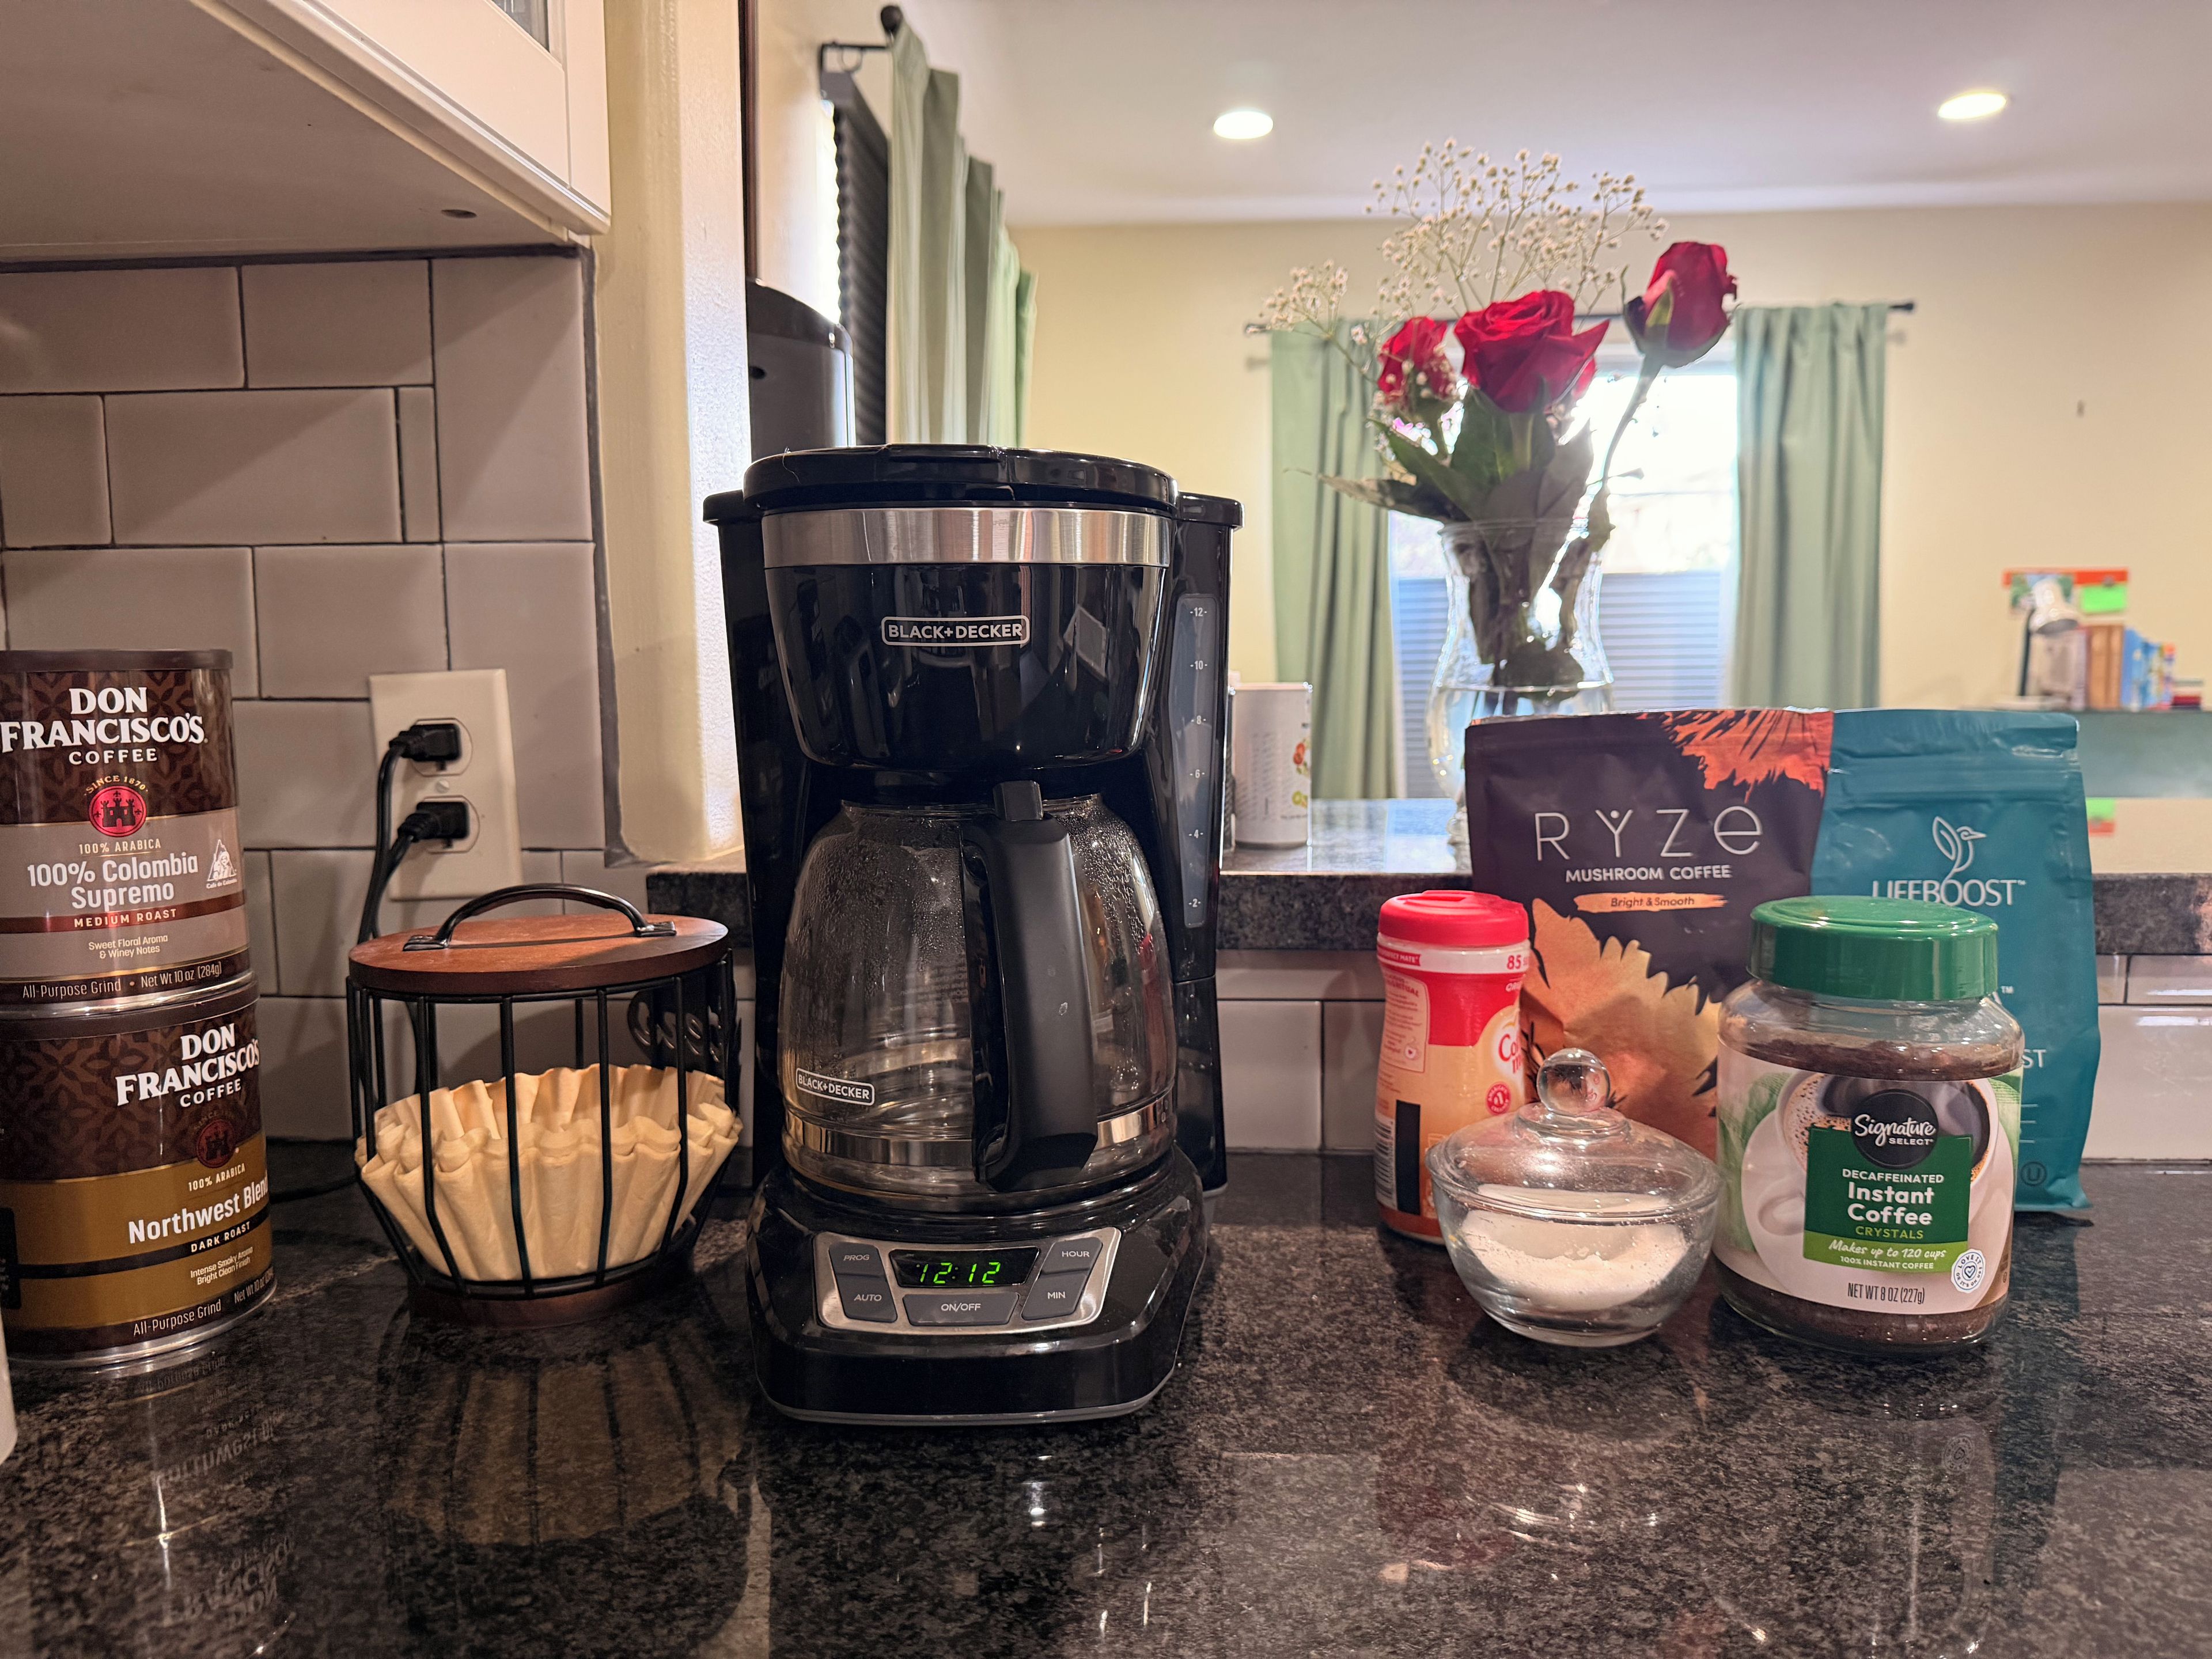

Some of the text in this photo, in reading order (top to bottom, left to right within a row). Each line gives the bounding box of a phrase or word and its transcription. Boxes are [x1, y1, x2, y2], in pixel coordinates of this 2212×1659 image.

[888, 624, 1022, 639] BLACK+DECKER
[69, 687, 147, 714] DON
[0, 713, 204, 752] FRANCISCO'S
[69, 748, 157, 765] COFFEE
[86, 775, 146, 793] SINCE 1870
[79, 839, 161, 854] 100% ARABICA
[28, 852, 198, 887] 100% Colombia
[1566, 865, 1731, 883] MUSHROOM COFFEE
[71, 882, 174, 911] Supremo
[1611, 896, 1694, 908] Bright & Smooth
[74, 908, 177, 927] MEDIUM ROAST
[89, 934, 168, 950] Sweet Floral Aroma
[99, 945, 160, 959] & Winey Notes
[1507, 955, 1521, 969] 85
[141, 963, 222, 988] Net Wt 10 oz (284g)
[23, 978, 121, 999] All-Purpose Grind
[180, 1023, 235, 1061] DON
[115, 1038, 260, 1107] FRANCISCO'S
[180, 1078, 241, 1108] COFFEE
[798, 1074, 870, 1100] BLACK+DECKER
[1854, 1113, 1937, 1147] Signature
[188, 1163, 245, 1192] 100% ARABICA
[1842, 1168, 1945, 1184] DECAFFEINATED
[1848, 1181, 1934, 1205] Instant
[128, 1192, 240, 1244] Northwest
[1847, 1203, 1933, 1225] Coffee
[191, 1221, 250, 1252] DARK ROAST
[1855, 1226, 1923, 1240] CRYSTALS
[1062, 1250, 1090, 1258] HOUR
[1828, 1239, 1947, 1261] Makes up to 120 cups
[191, 1264, 217, 1278] Intense
[218, 1255, 237, 1268] Smoky
[1840, 1256, 1862, 1265] 100%
[1863, 1259, 1900, 1268] INSTANT
[1957, 1254, 1974, 1268] LOVE
[198, 1272, 218, 1285] Bright
[854, 1294, 882, 1302] AUTO
[1047, 1291, 1066, 1300] MIN
[1847, 1282, 1925, 1305] NET WT 8 OZ (227g)
[133, 1299, 222, 1336] All-Purpose Grind
[941, 1302, 981, 1312] ON/OFF
